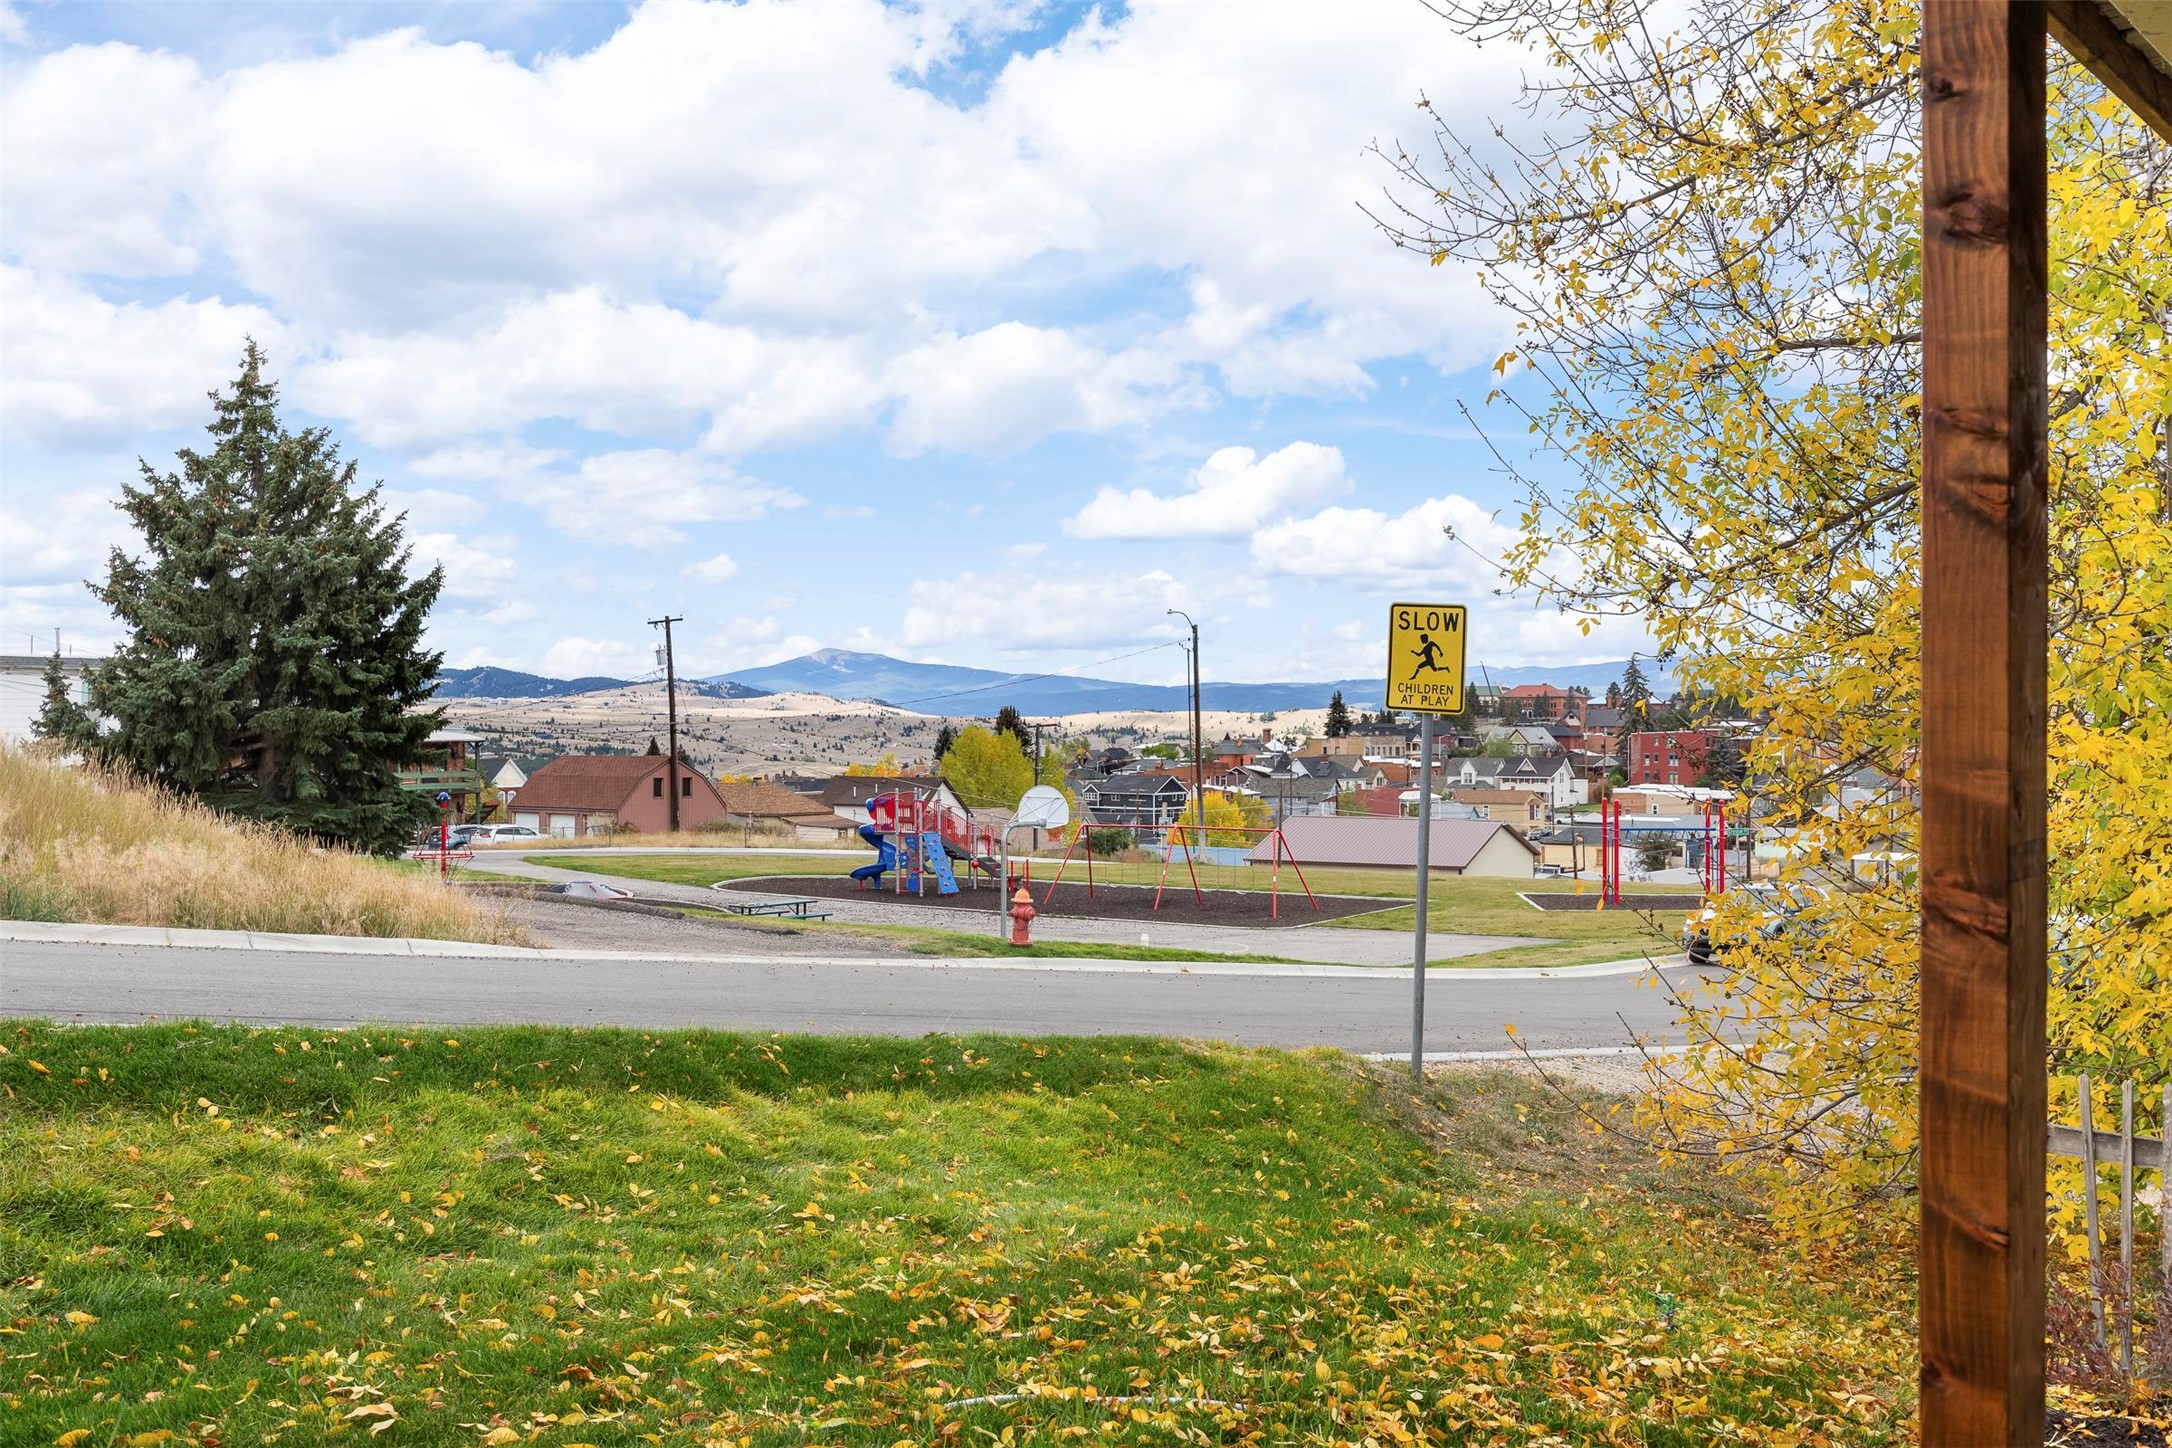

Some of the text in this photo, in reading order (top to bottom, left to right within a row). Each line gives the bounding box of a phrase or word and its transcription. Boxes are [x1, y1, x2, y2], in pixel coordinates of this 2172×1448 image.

[1398, 610, 1459, 632] SLOW
[1397, 682, 1454, 695] CHILDREN
[1400, 694, 1450, 707] AT PLAY
